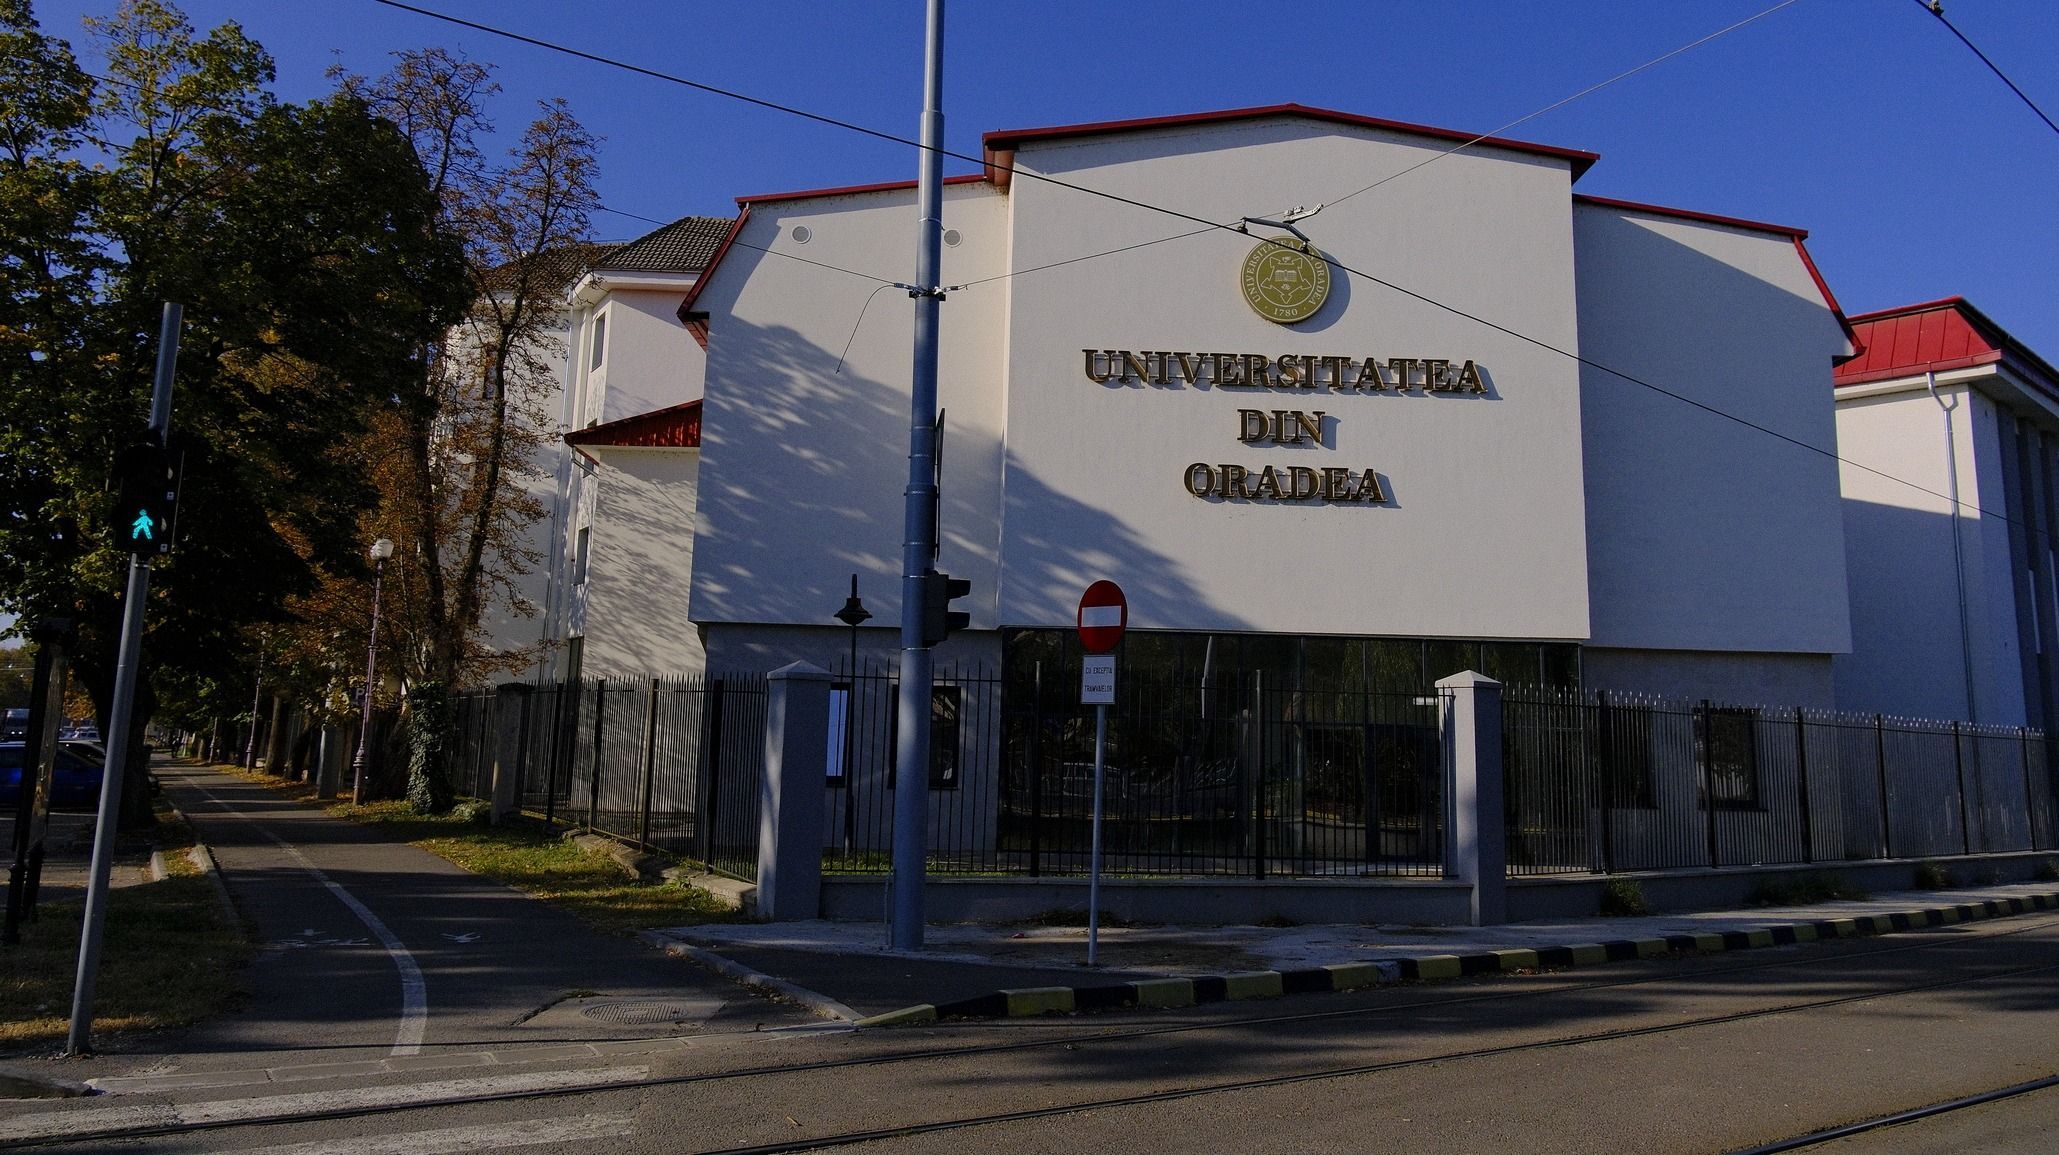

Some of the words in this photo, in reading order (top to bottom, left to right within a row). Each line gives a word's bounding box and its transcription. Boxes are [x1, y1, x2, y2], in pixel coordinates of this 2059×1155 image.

[1309, 262, 1325, 305] ORADEA
[1274, 308, 1298, 316] 1780
[1082, 349, 1487, 393] UNIVERSITATEA
[1237, 409, 1325, 444] DIN
[1183, 463, 1388, 502] ORADEA
[356, 688, 365, 700] P
